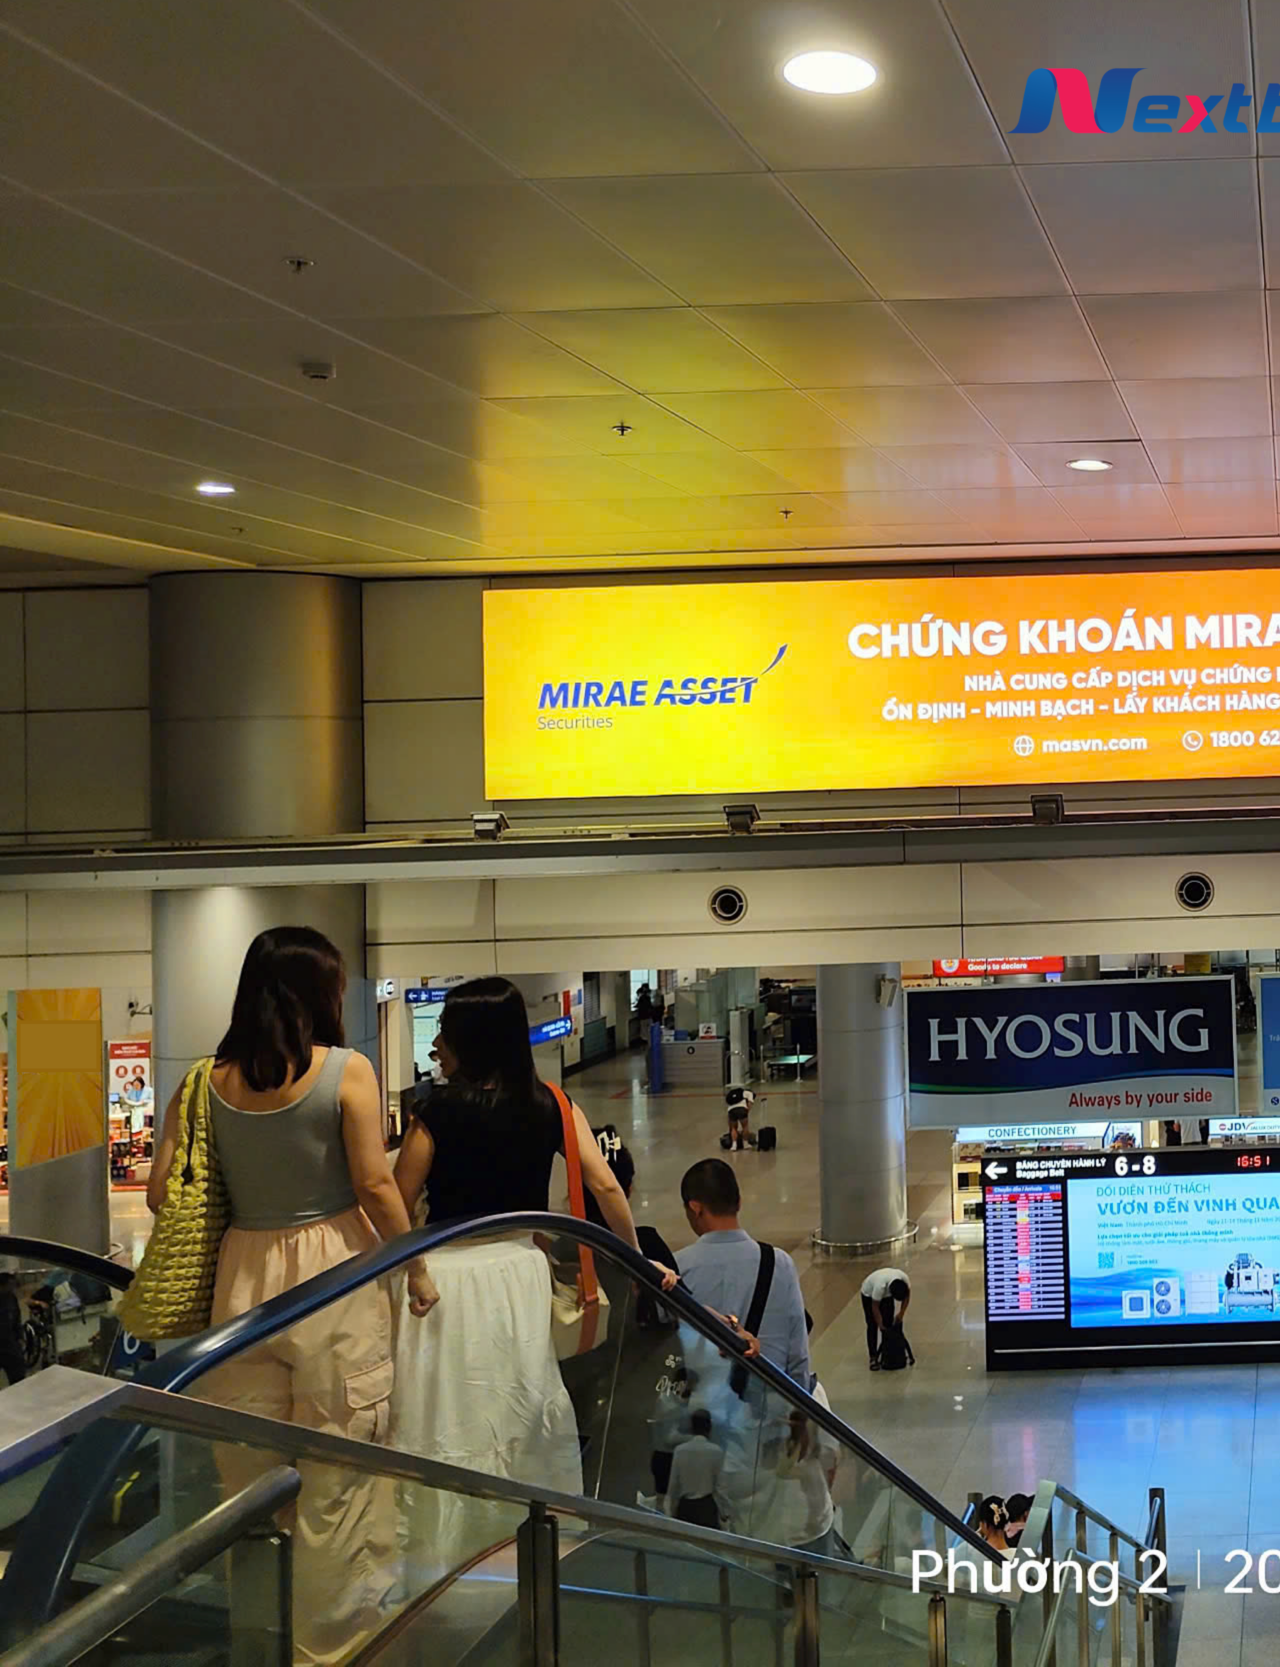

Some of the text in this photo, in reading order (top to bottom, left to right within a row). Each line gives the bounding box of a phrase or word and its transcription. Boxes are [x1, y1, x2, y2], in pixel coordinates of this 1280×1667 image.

[847, 613, 1008, 660] CHỨNG
[1018, 608, 1174, 655] KHOÁN
[964, 671, 1006, 692] NHÀ
[1009, 673, 1068, 691] CUNG
[1071, 666, 1113, 690] CẤP
[1117, 669, 1165, 691] DỊCH
[1169, 668, 1197, 690] VỤ
[1200, 663, 1273, 686] CHỨNG
[538, 676, 759, 710] MIRAE ASSET
[881, 696, 913, 722] ỔN
[917, 702, 967, 723] ĐỊNH
[985, 700, 1036, 718] MINH
[1040, 698, 1095, 721] BẠCH
[1113, 691, 1148, 714] LẤY
[1152, 692, 1221, 714] KHÁCH
[537, 714, 614, 731] Securities
[1041, 735, 1148, 754] masvn.com
[1209, 730, 1255, 748] 1800
[1001, 962, 1028, 971] declare
[927, 1007, 1210, 1062] HYOSUNG
[1068, 1087, 1213, 1111] Always by your side
[988, 1125, 1077, 1139] CONFECTIONERY
[1015, 1168, 1065, 1180] Baggage Belt
[1174, 1181, 1211, 1195] THÁCH
[1097, 1199, 1148, 1216] VƯƠN
[1194, 1198, 1238, 1213] VINH
[123, 1329, 141, 1356] 6
